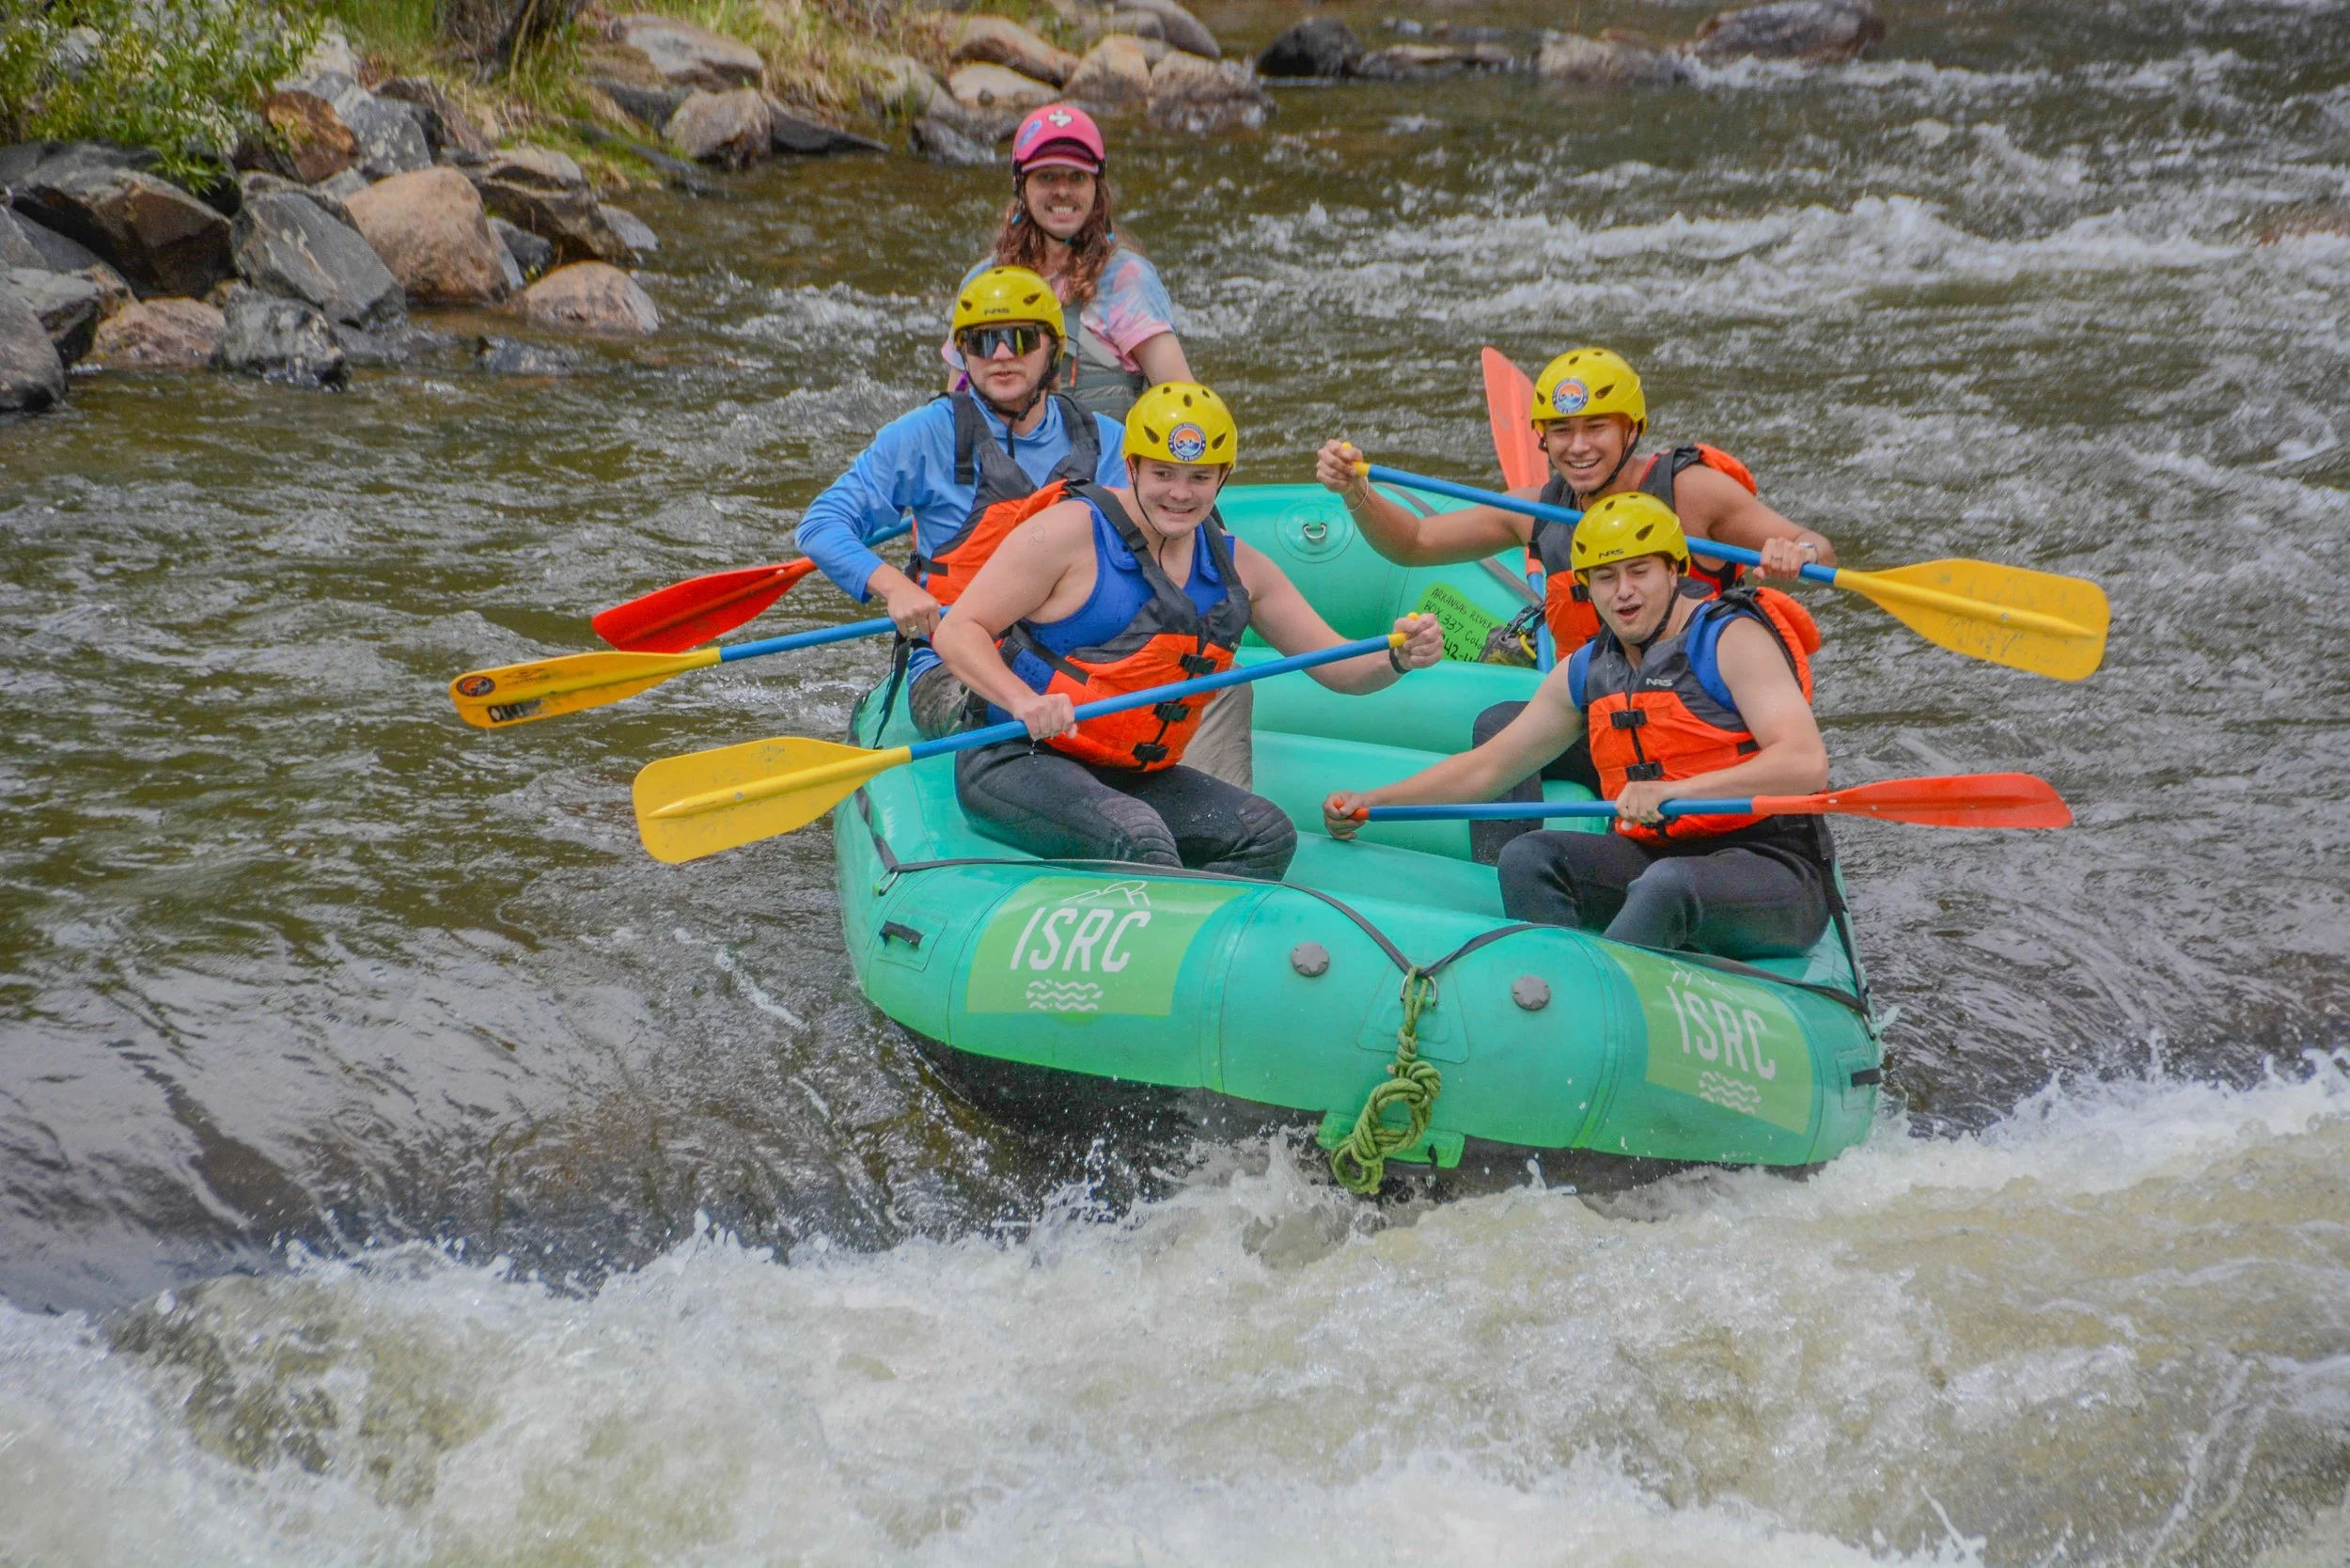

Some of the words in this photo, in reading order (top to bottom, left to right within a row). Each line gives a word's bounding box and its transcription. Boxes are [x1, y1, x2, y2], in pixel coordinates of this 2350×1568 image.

[1599, 549, 1624, 559] NRS
[1423, 599, 1444, 619] BOX
[1441, 613, 1465, 635] 337
[1431, 588, 1467, 616] ARKANSAS
[1468, 610, 1494, 630] RIVER
[1646, 678, 1673, 687] NRS
[1010, 906, 1152, 972] ISRC
[1666, 985, 1776, 1080] ISRC
